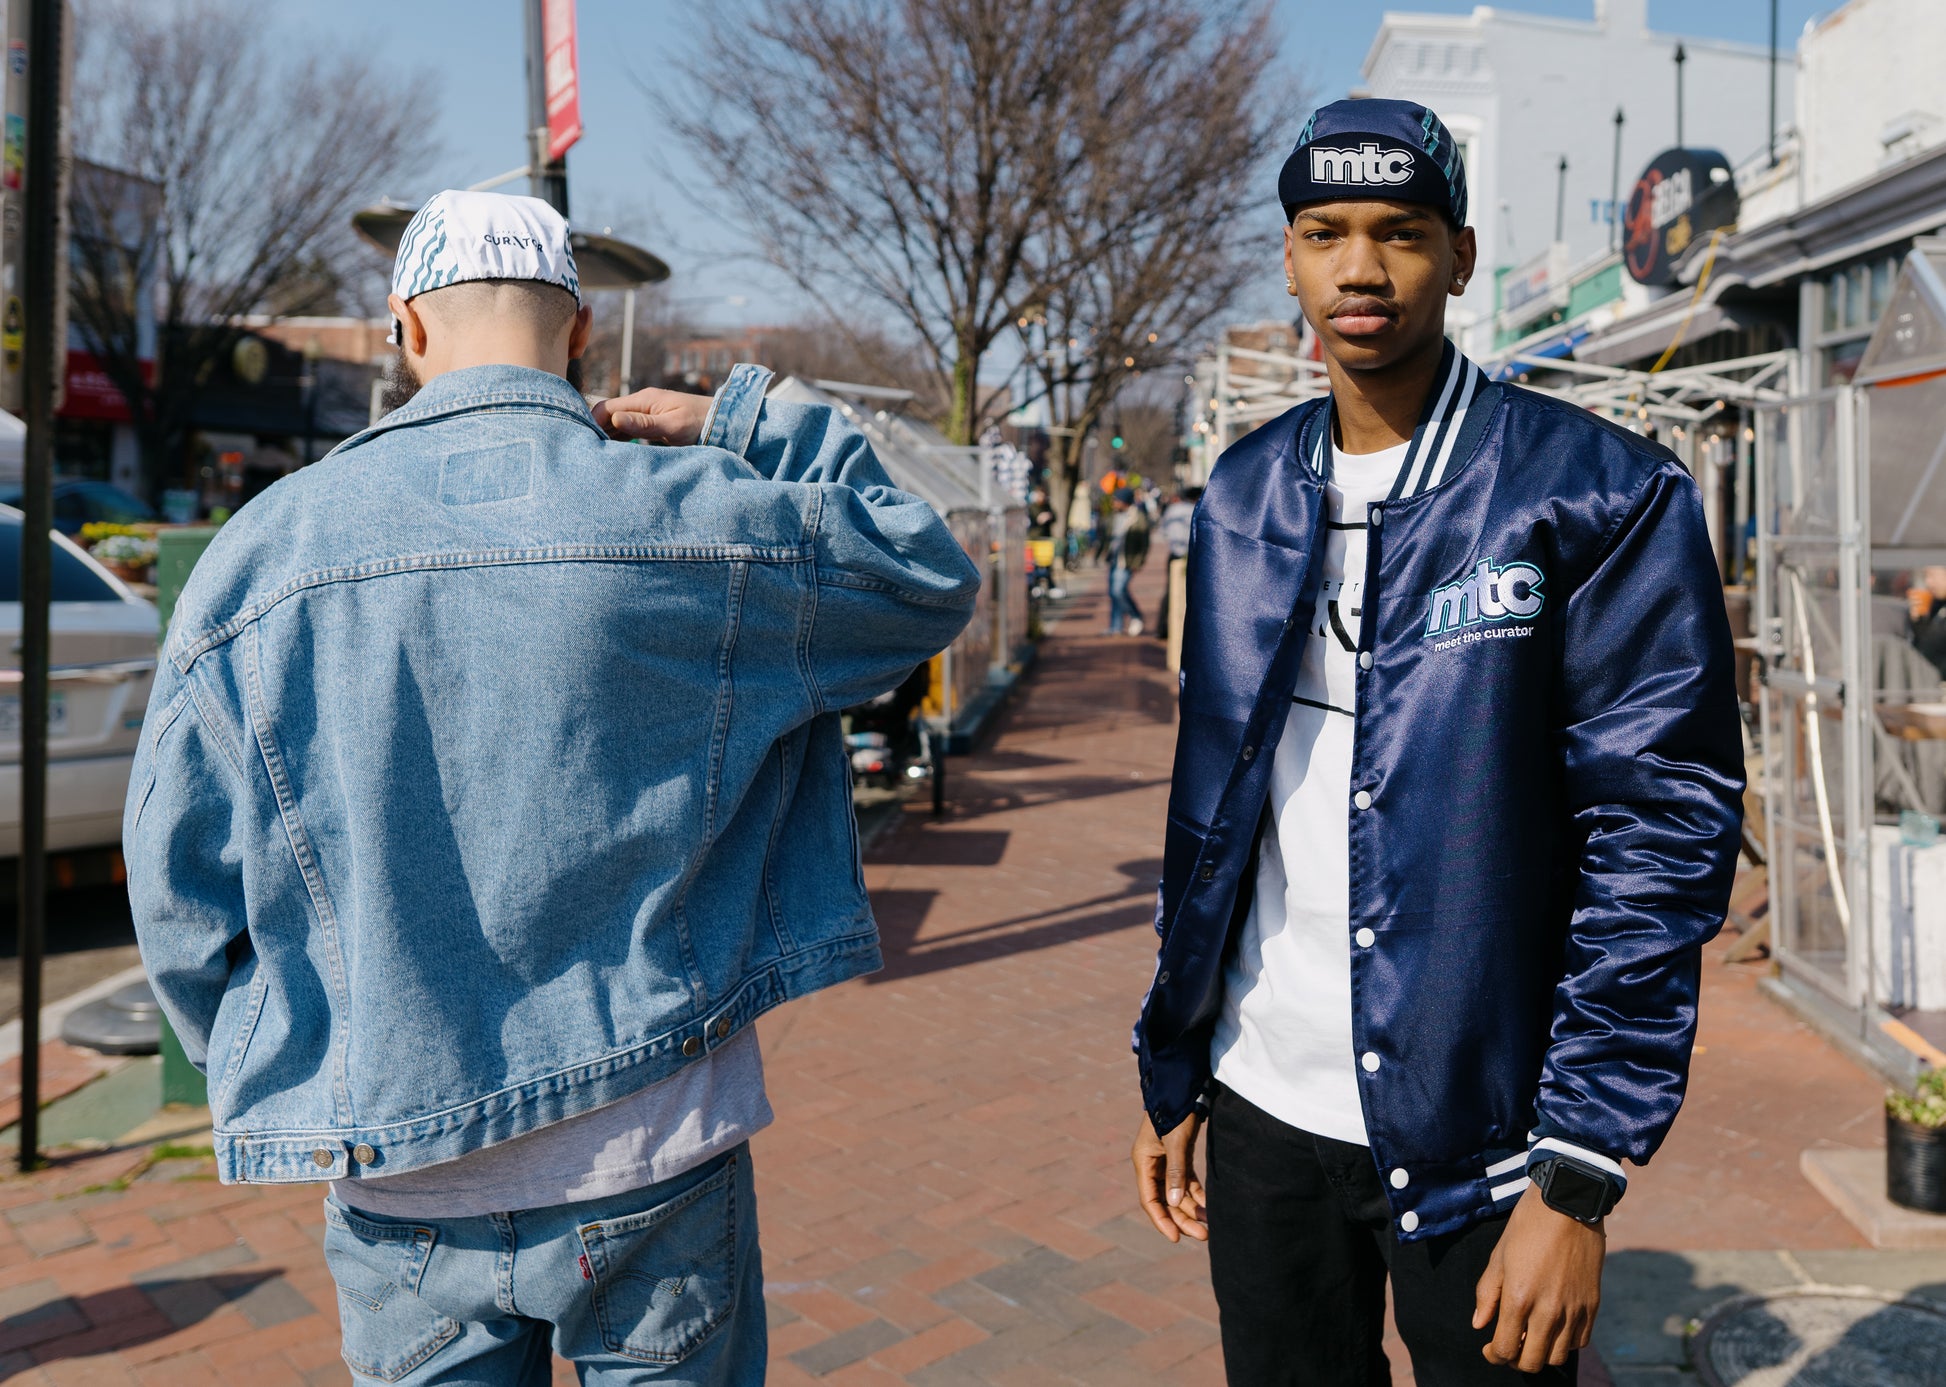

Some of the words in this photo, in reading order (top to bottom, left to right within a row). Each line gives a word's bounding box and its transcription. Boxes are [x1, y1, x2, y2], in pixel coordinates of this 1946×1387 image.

[1310, 143, 1415, 186] mtc
[1424, 556, 1546, 638] mtc
[1434, 638, 1462, 653] meet
[1462, 631, 1482, 644] the
[1484, 626, 1535, 639] curator
